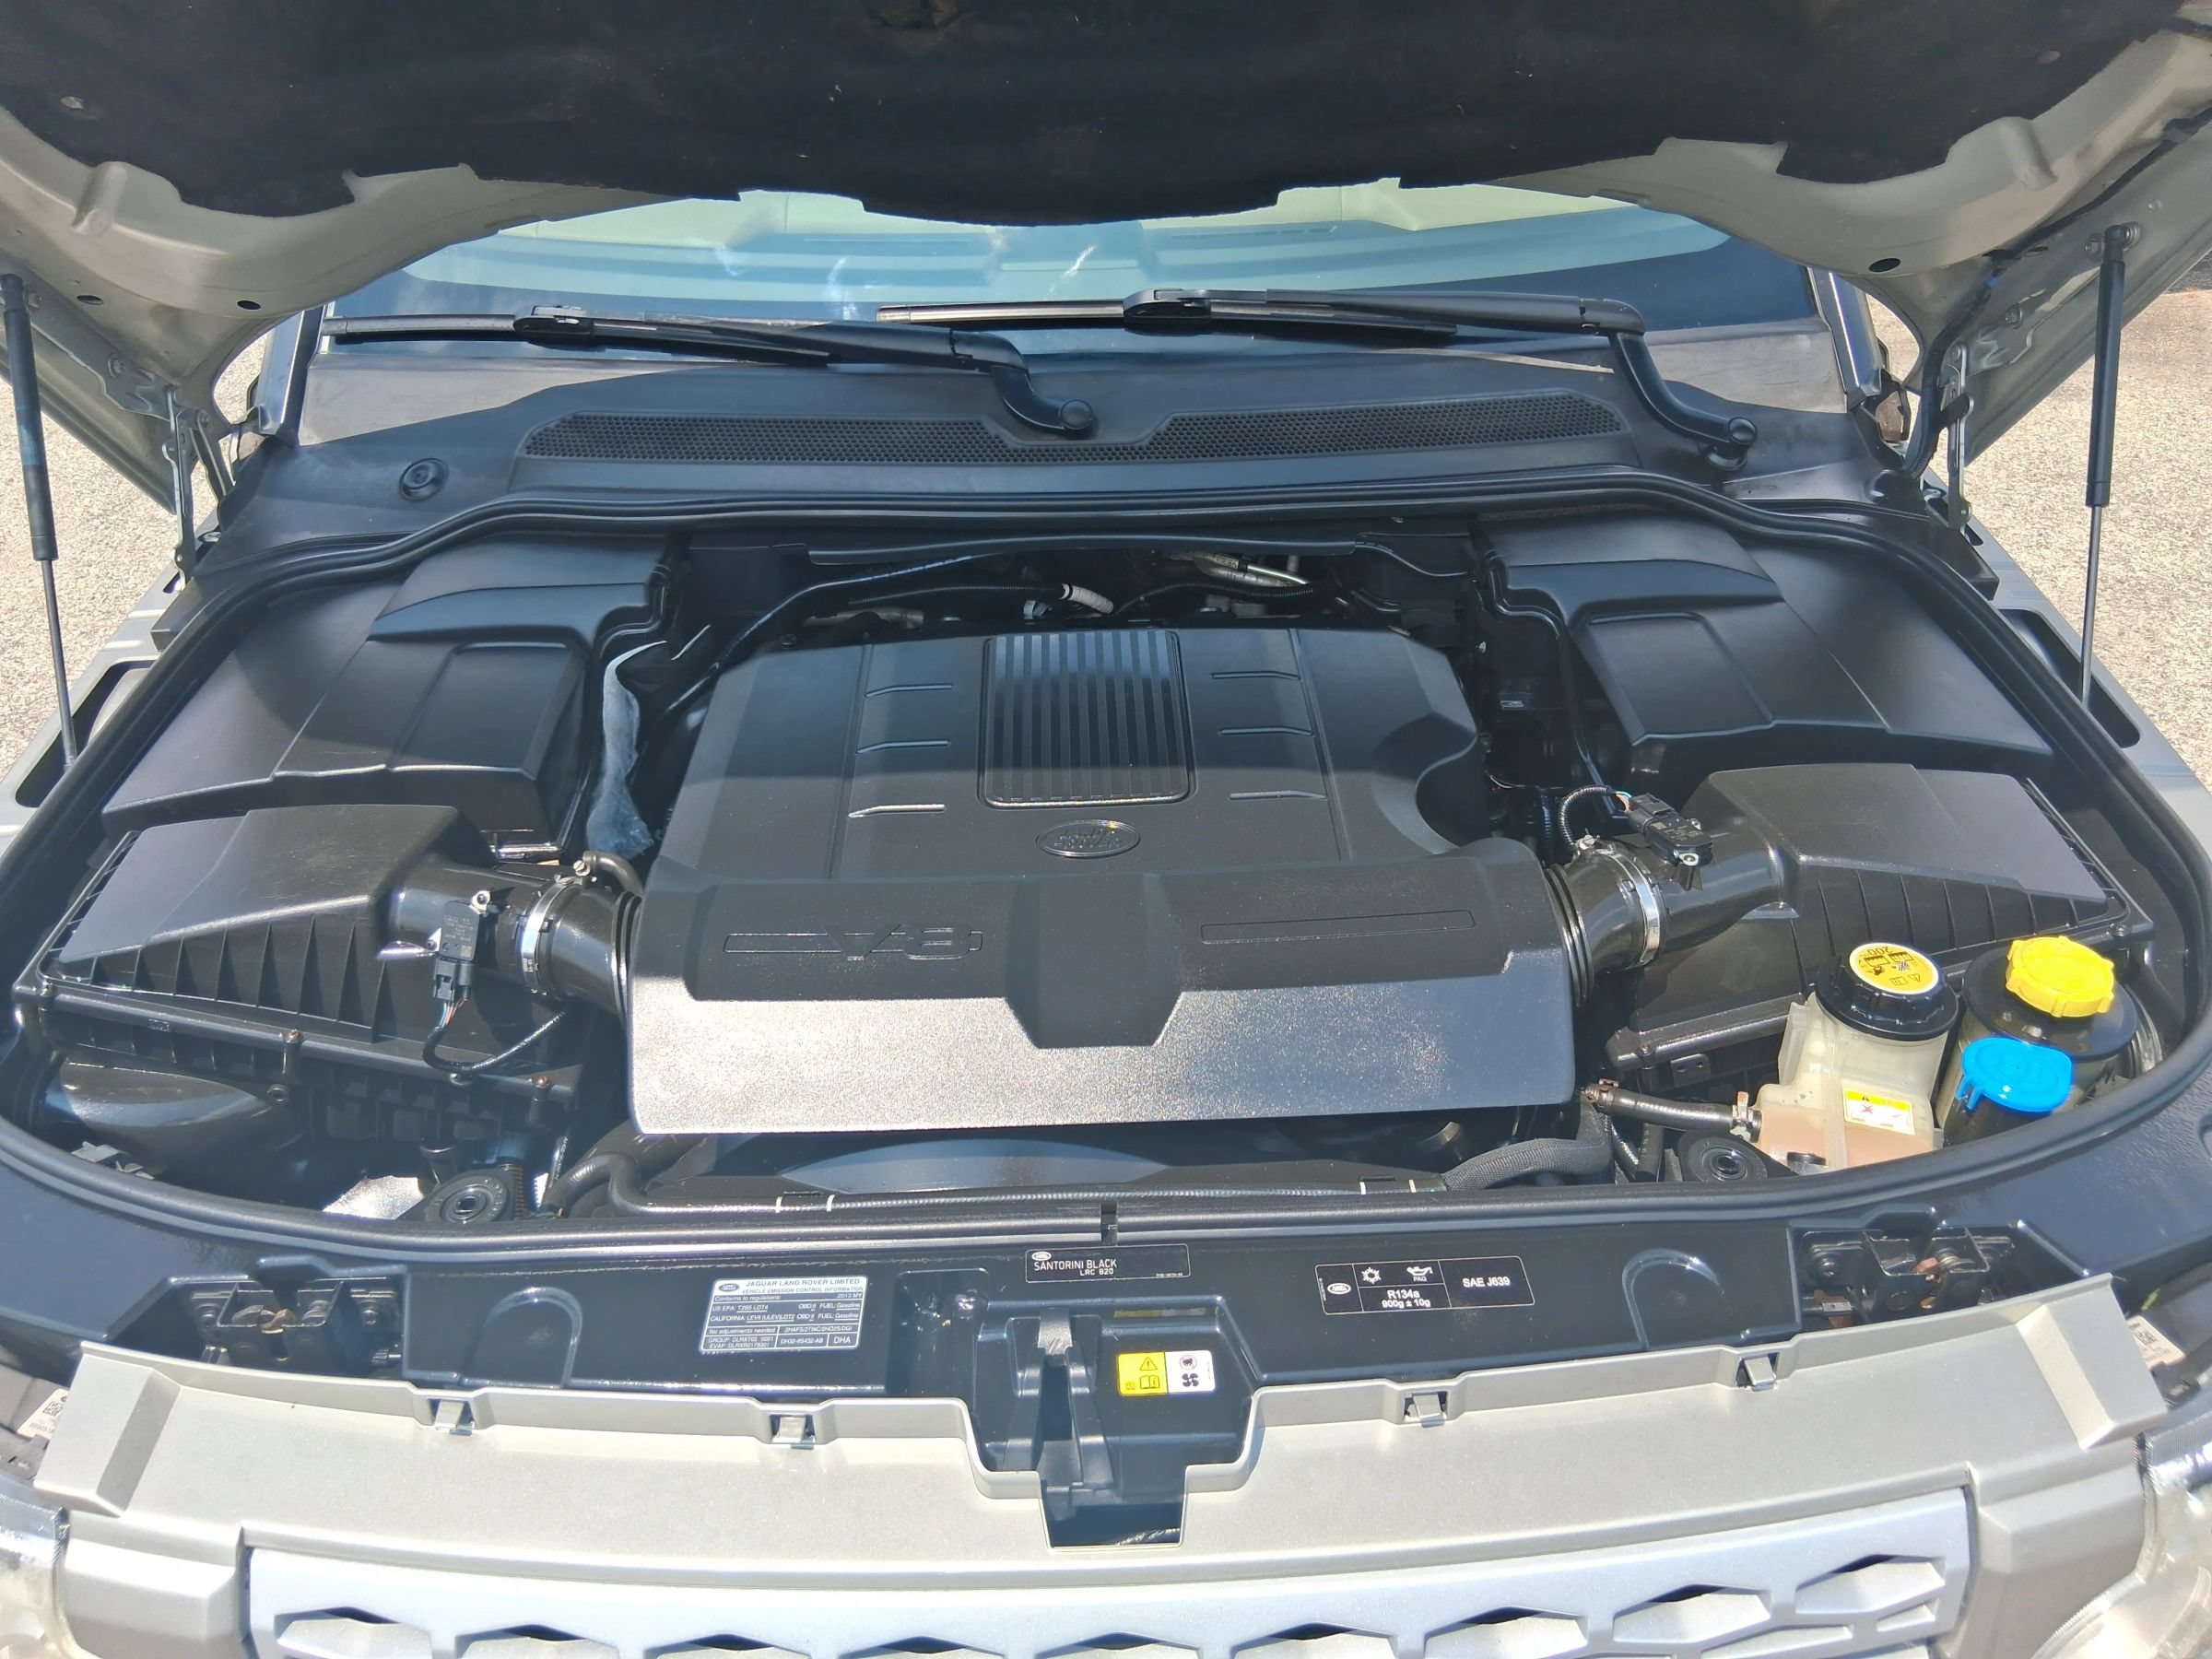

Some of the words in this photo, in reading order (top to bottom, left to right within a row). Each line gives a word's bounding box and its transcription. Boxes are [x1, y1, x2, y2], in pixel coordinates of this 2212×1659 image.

[1033, 1261, 1084, 1271] SANTORINI
[1087, 1259, 1117, 1269] BLACK
[1462, 1277, 1486, 1288] SAE
[1487, 1277, 1511, 1287] J639
[1387, 1289, 1420, 1300] R134a
[1382, 1300, 1405, 1309] 900g
[1414, 1299, 1431, 1309] 10g
